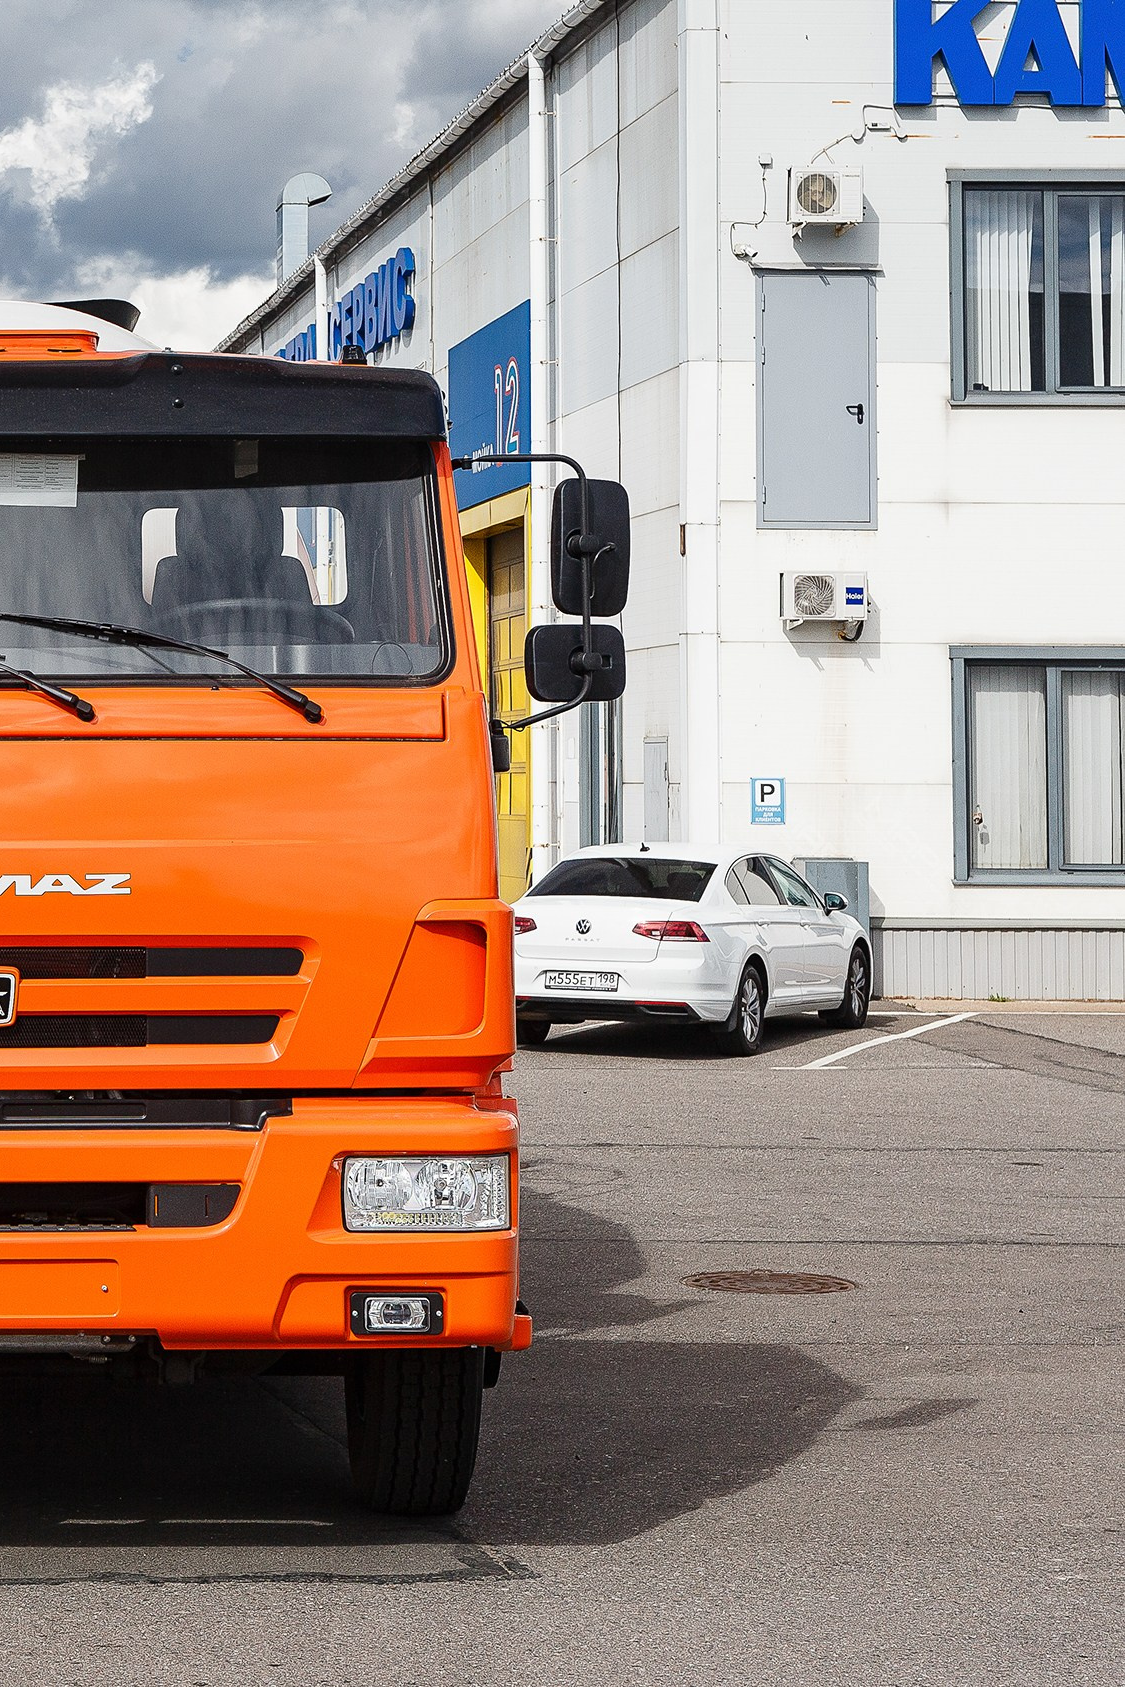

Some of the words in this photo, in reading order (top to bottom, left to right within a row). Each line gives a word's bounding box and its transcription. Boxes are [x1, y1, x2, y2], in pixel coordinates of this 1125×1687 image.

[494, 356, 520, 467] 12
[846, 592, 863, 600] Haier
[760, 783, 775, 803] P
[597, 973, 615, 984] 198
